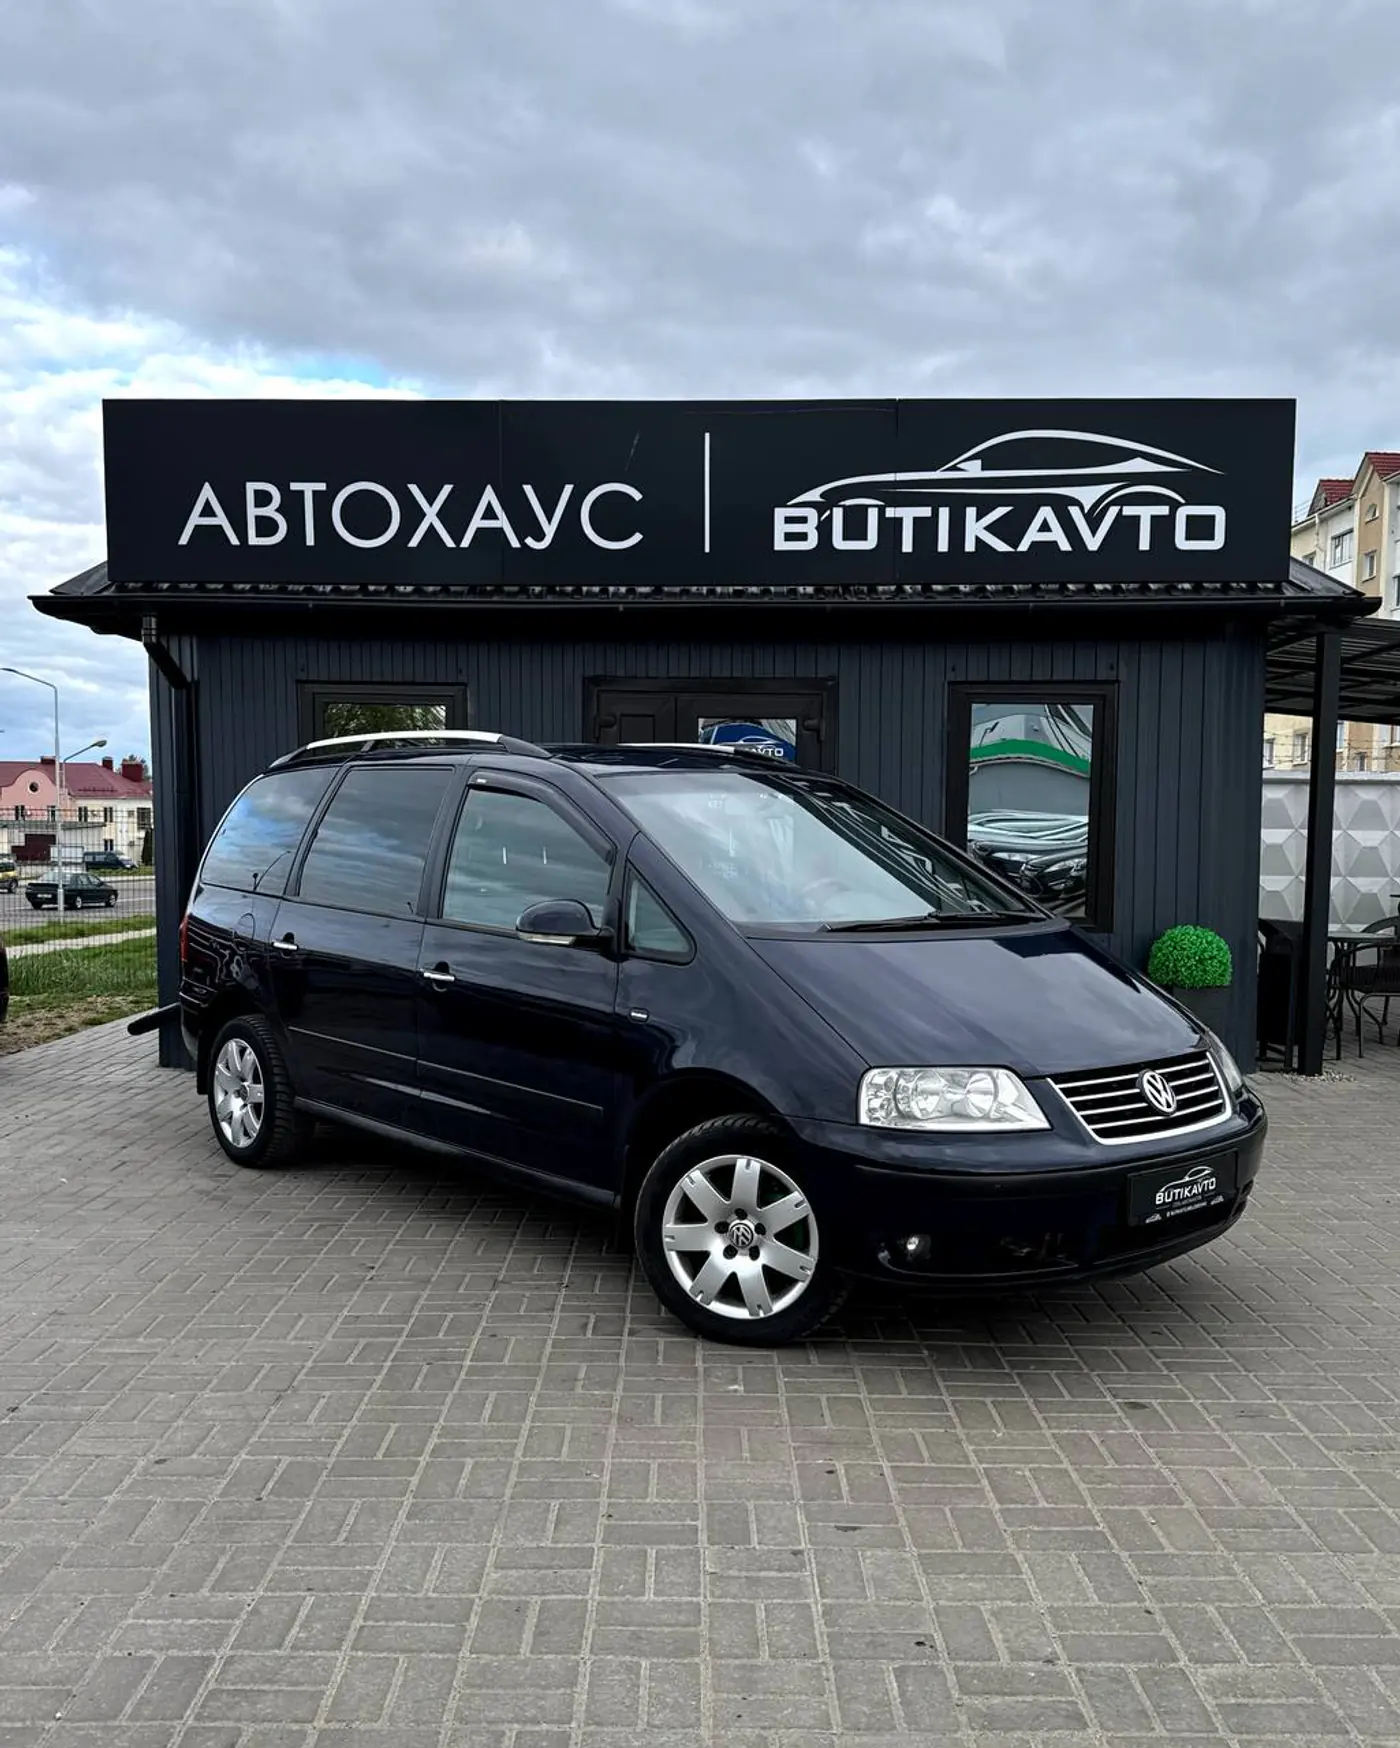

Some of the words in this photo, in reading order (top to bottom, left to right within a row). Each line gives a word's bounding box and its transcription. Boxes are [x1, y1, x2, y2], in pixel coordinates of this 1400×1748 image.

[177, 480, 645, 550] АВТОХАУС
[773, 505, 1226, 553] BUTIKAVTO
[1155, 1177, 1217, 1205] BUTIKAVTO
